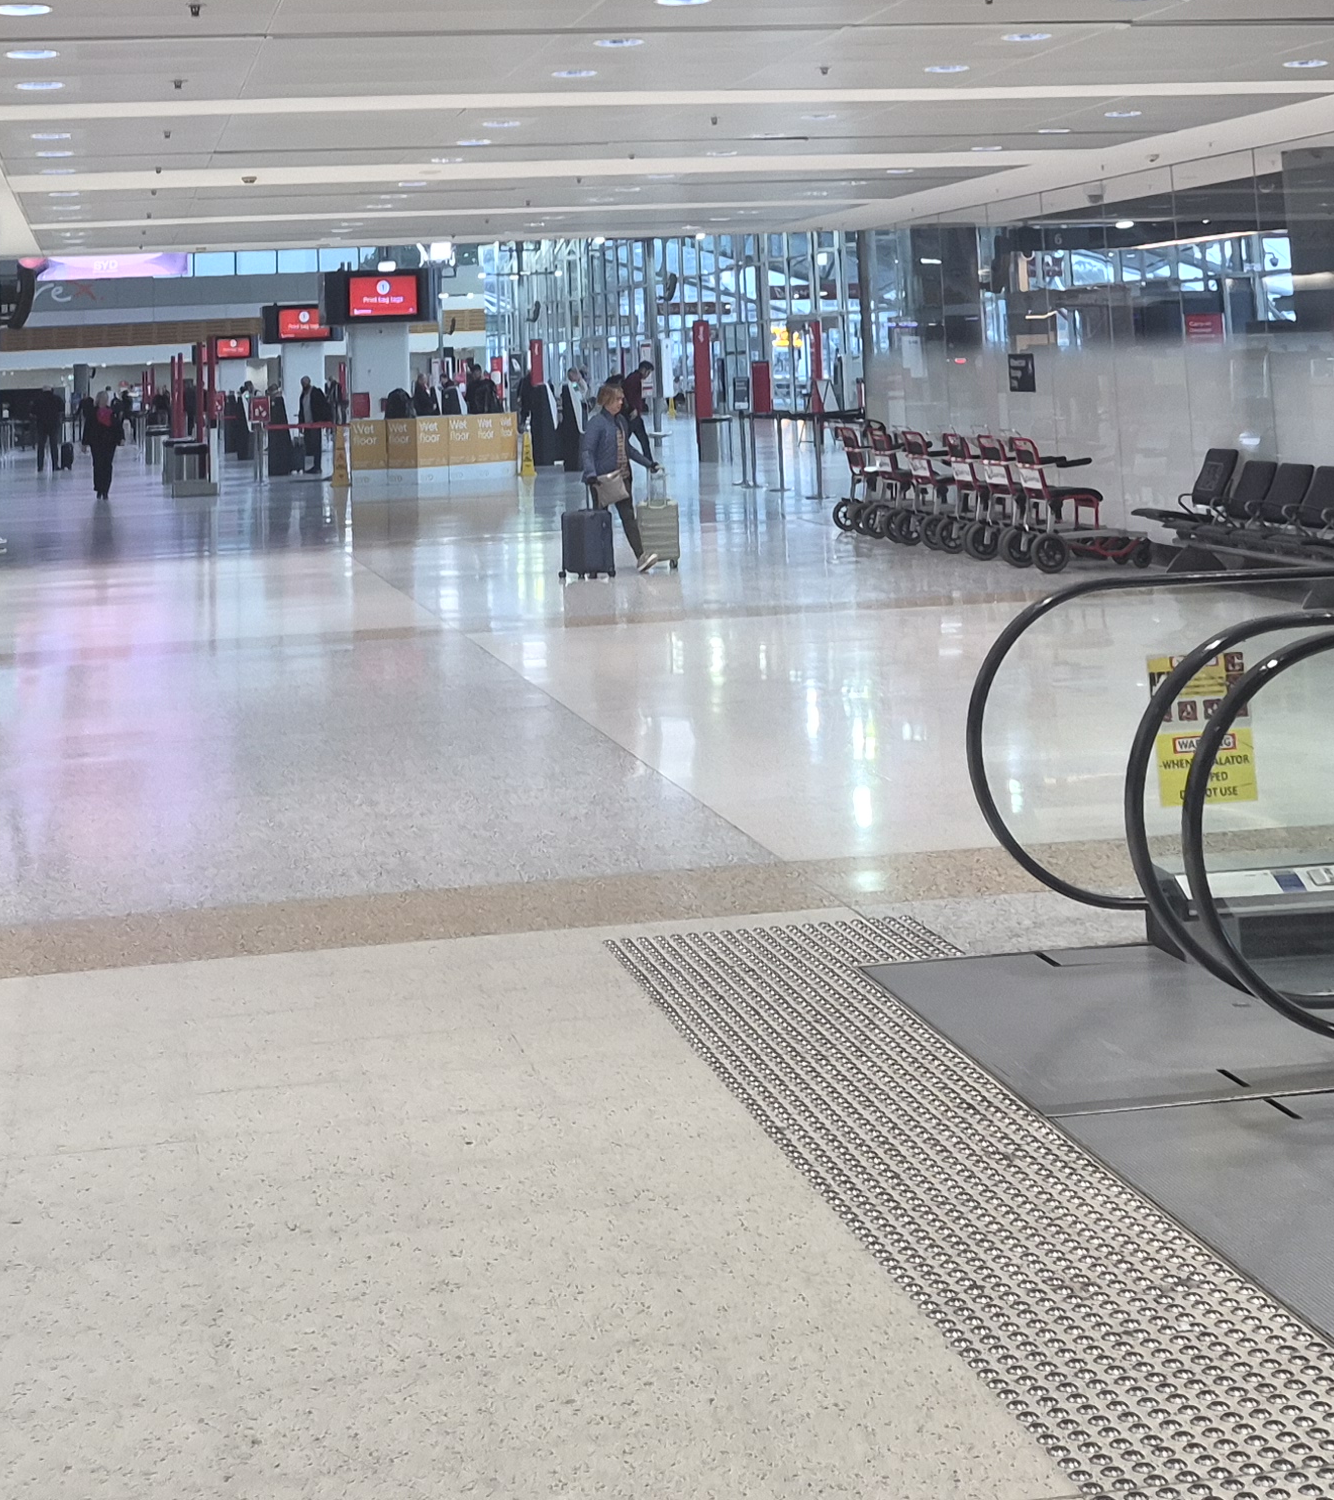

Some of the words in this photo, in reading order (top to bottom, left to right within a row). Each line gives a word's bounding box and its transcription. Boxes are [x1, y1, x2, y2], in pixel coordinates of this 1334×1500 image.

[93, 259, 118, 271] SYD
[352, 423, 375, 435] Wet
[388, 422, 408, 433] Wet
[419, 421, 438, 432] Wet
[449, 419, 468, 430] Wet
[353, 436, 378, 446] floor
[419, 433, 441, 444] floor
[1219, 785, 1239, 797] USE
